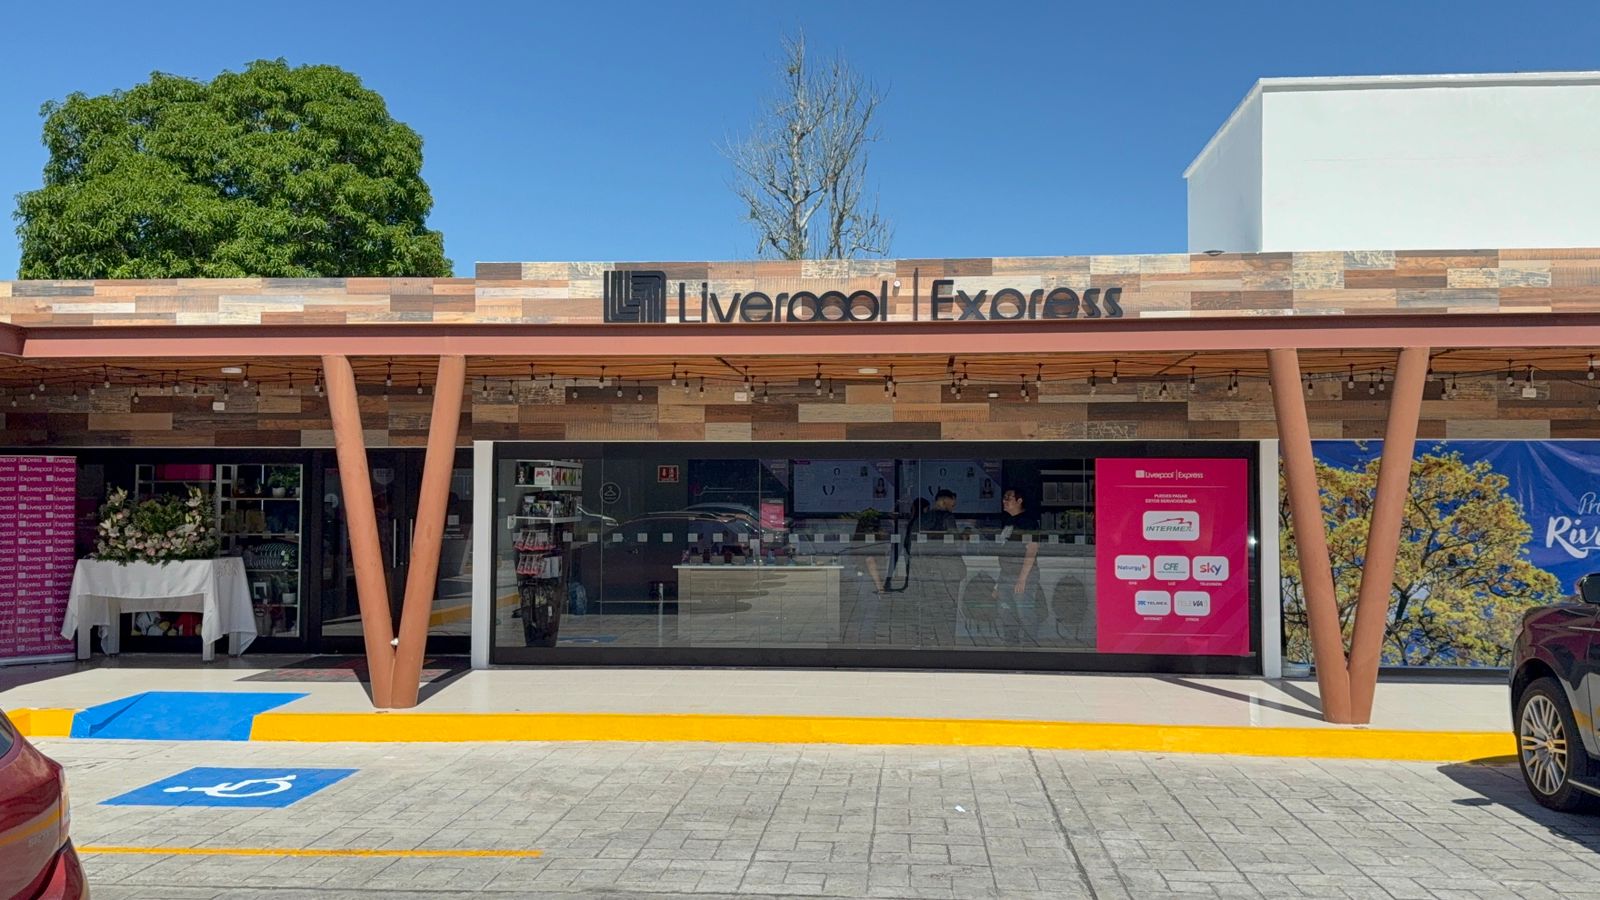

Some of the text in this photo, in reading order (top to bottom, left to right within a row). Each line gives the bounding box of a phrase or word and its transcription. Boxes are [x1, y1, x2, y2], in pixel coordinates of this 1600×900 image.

[679, 280, 1123, 322] Liverpool Express
[1146, 471, 1174, 479] Liverpool
[1200, 562, 1222, 576] sky
